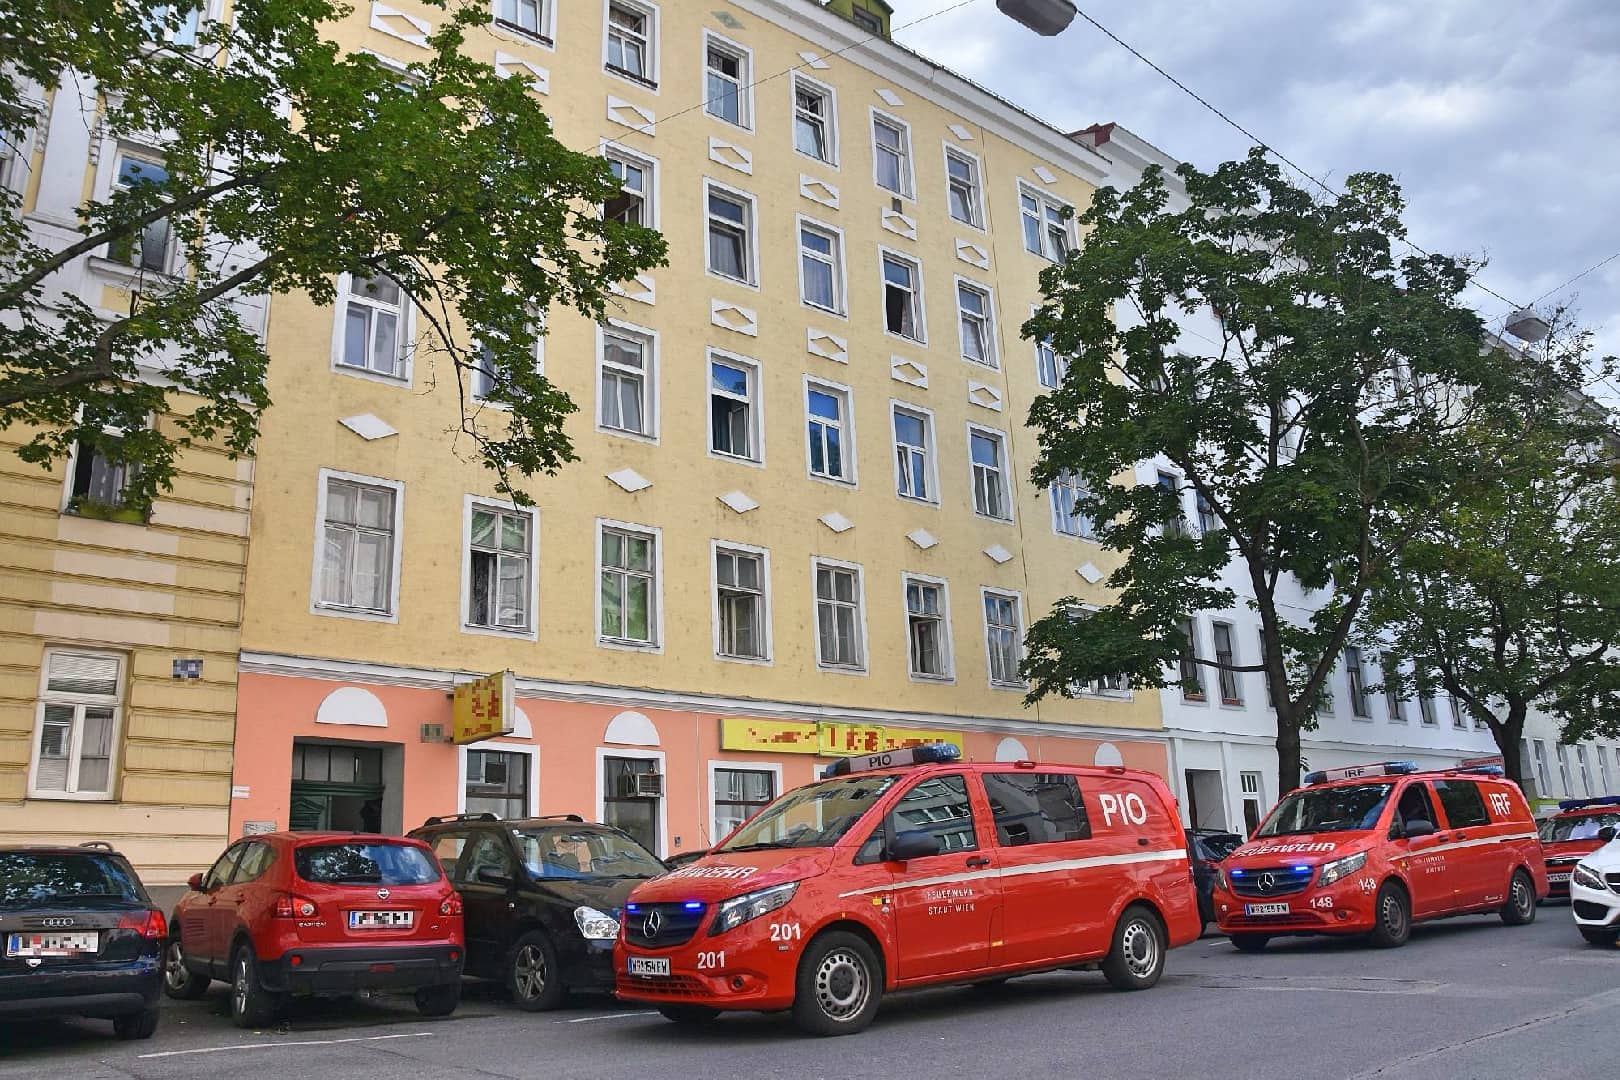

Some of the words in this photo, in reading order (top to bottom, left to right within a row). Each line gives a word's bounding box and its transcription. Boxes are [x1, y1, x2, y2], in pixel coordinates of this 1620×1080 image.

[869, 754, 892, 768] PIO
[1344, 767, 1366, 778] IRF
[1098, 793, 1147, 827] PIO
[1488, 792, 1511, 816] IRF
[1358, 877, 1377, 891] 148
[955, 903, 975, 913] WIEN
[1309, 897, 1334, 909] 148
[769, 923, 801, 942] 201
[697, 950, 726, 969] 201
